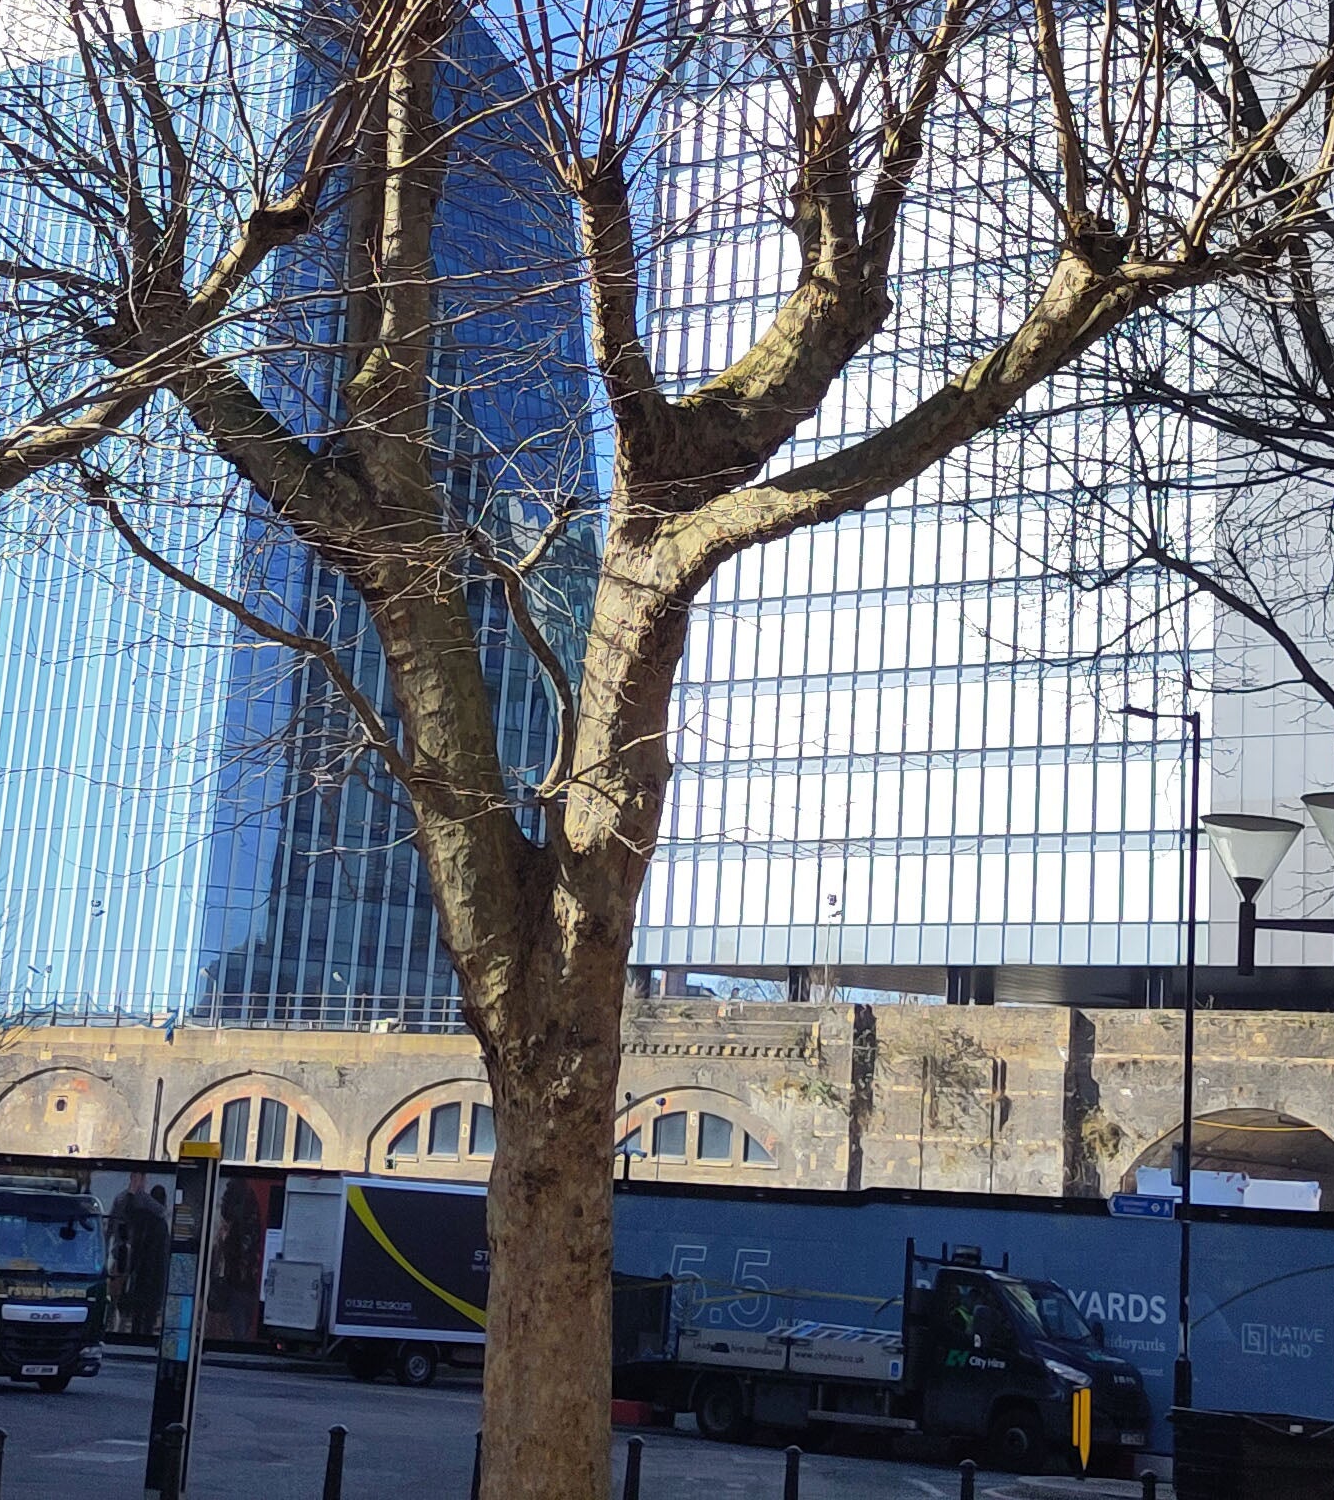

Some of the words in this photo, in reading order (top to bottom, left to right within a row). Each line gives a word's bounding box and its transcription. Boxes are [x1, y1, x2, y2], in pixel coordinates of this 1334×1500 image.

[669, 1244, 771, 1327] 5.5
[1068, 1288, 1167, 1324] YARDS
[29, 1312, 63, 1321] DAF
[1270, 1325, 1326, 1343] NATIVE
[1270, 1342, 1314, 1358] LAND
[969, 1355, 987, 1370] City
